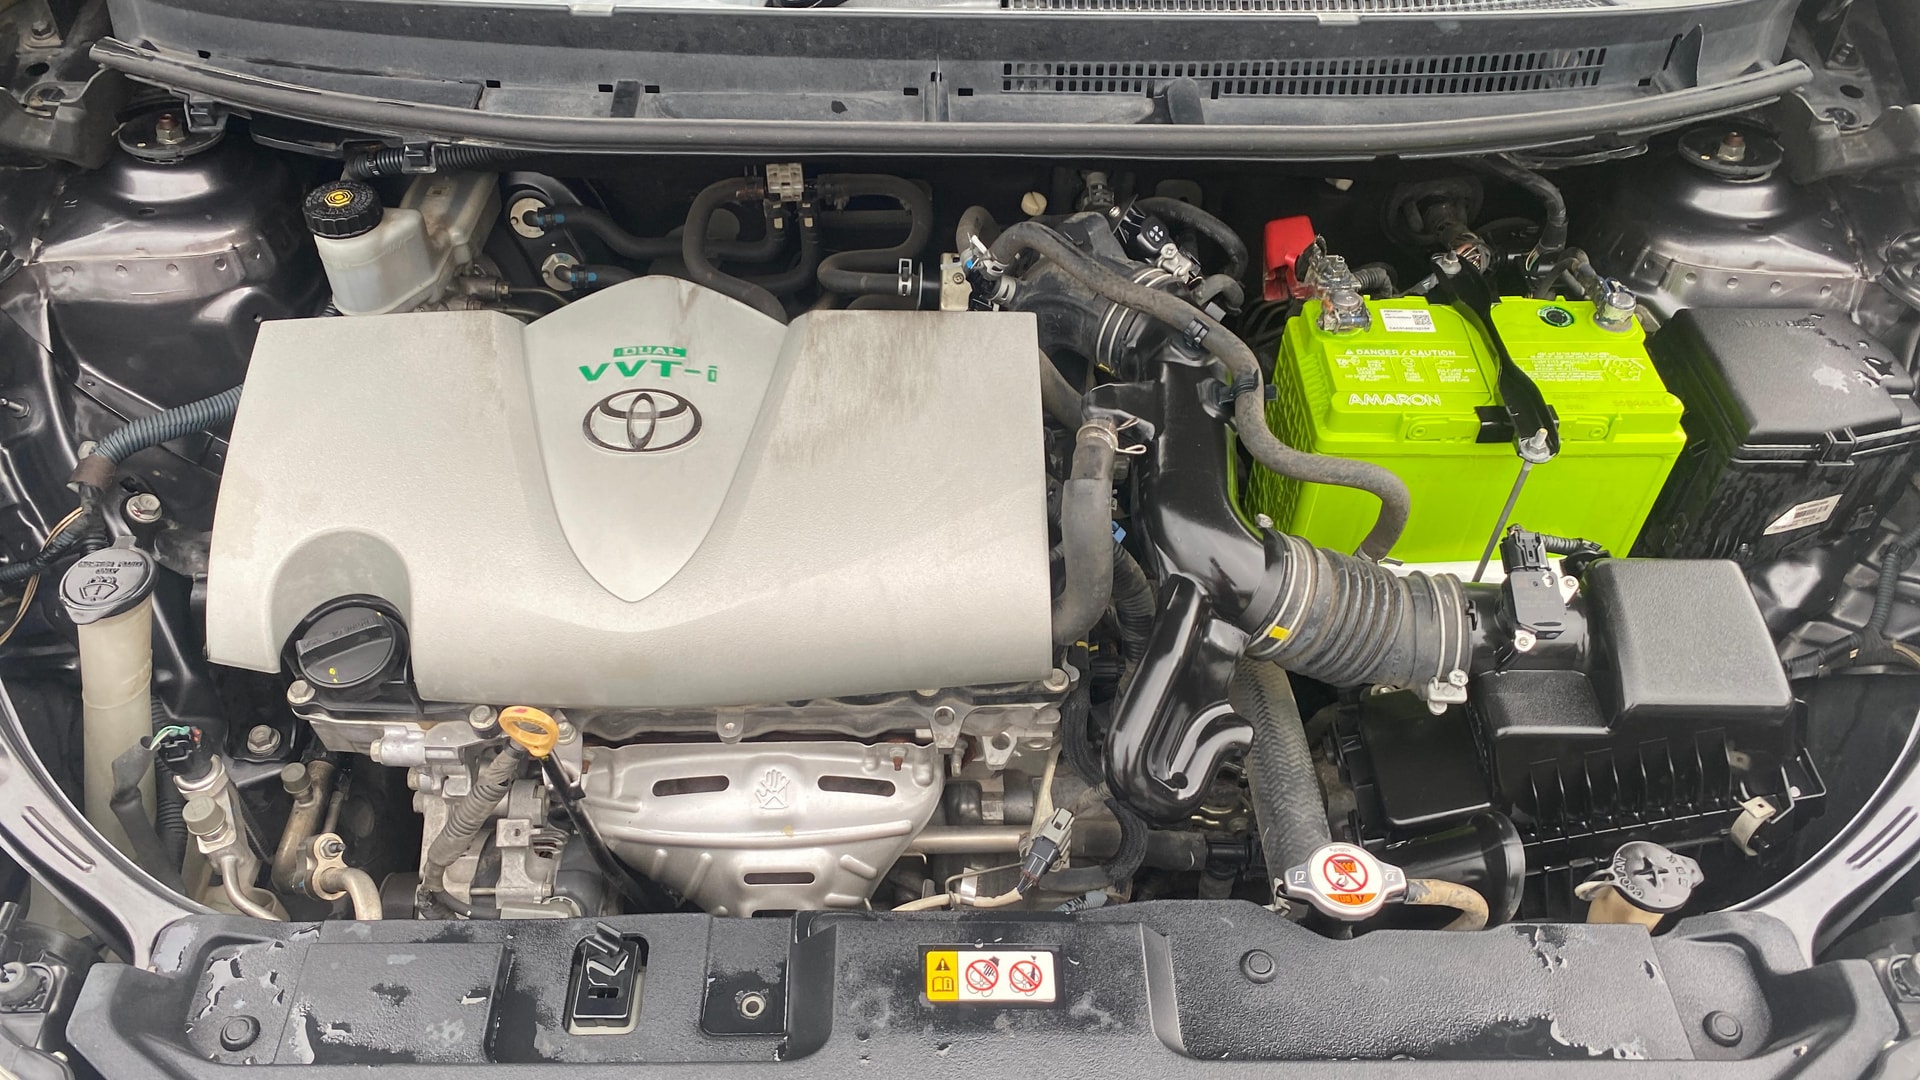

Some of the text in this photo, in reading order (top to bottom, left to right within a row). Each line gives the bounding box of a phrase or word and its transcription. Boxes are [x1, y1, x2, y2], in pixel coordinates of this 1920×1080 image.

[623, 346, 680, 356] DUAL
[578, 359, 718, 382] VVT-i
[1348, 393, 1441, 407] AMARON
